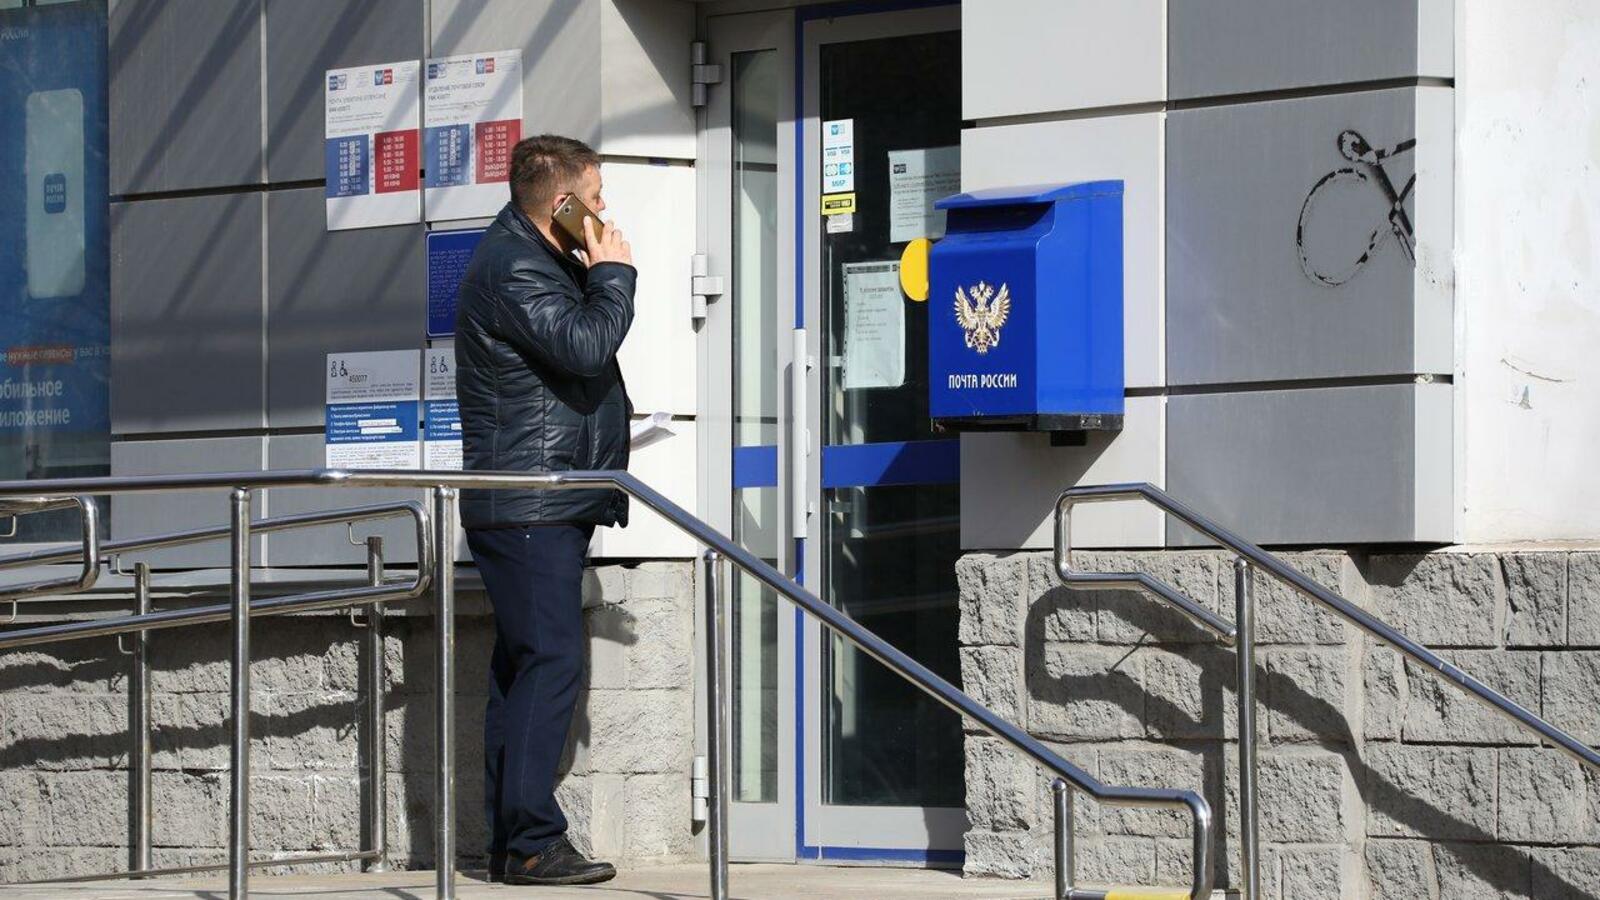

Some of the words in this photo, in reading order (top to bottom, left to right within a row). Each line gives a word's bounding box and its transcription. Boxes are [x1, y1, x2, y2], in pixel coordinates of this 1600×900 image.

[349, 374, 368, 383] 450077
[948, 374, 978, 389] ПОЧТА
[980, 373, 1017, 388] РОССИИ
